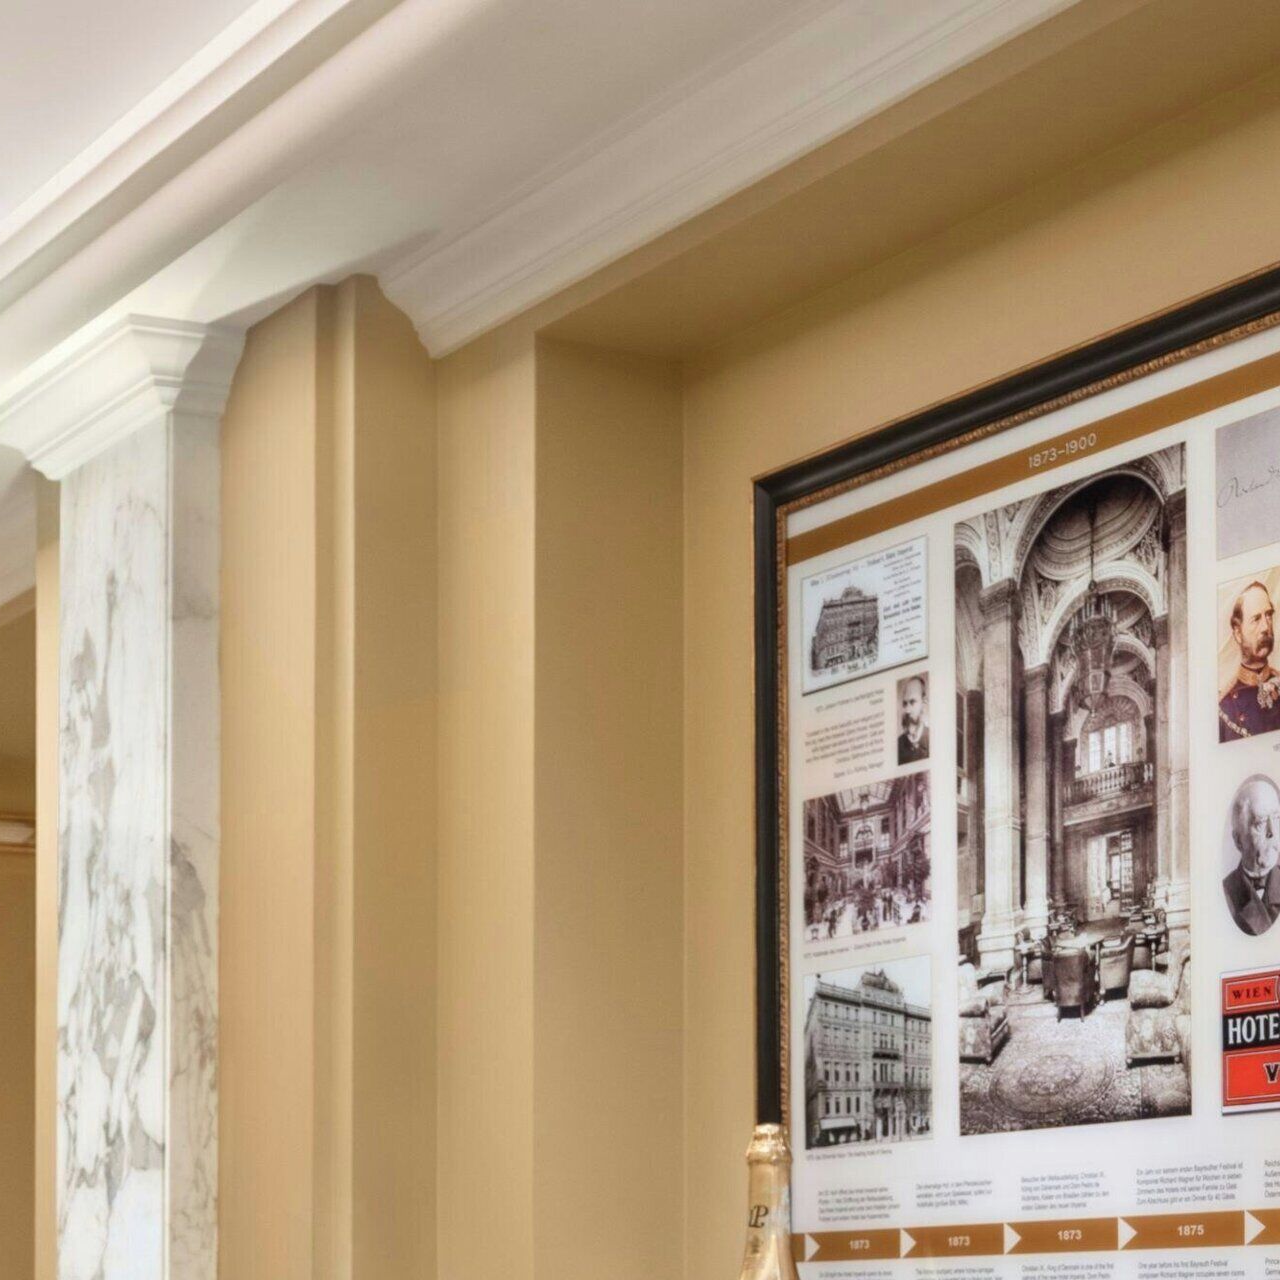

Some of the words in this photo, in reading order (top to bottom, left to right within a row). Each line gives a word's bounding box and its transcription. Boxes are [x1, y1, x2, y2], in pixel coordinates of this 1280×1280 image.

[1232, 986, 1272, 1000] WIEN
[849, 1240, 870, 1250] 1873
[948, 1236, 970, 1247] 1873
[1058, 1230, 1082, 1240] 1873
[1177, 1224, 1204, 1236] 1875
